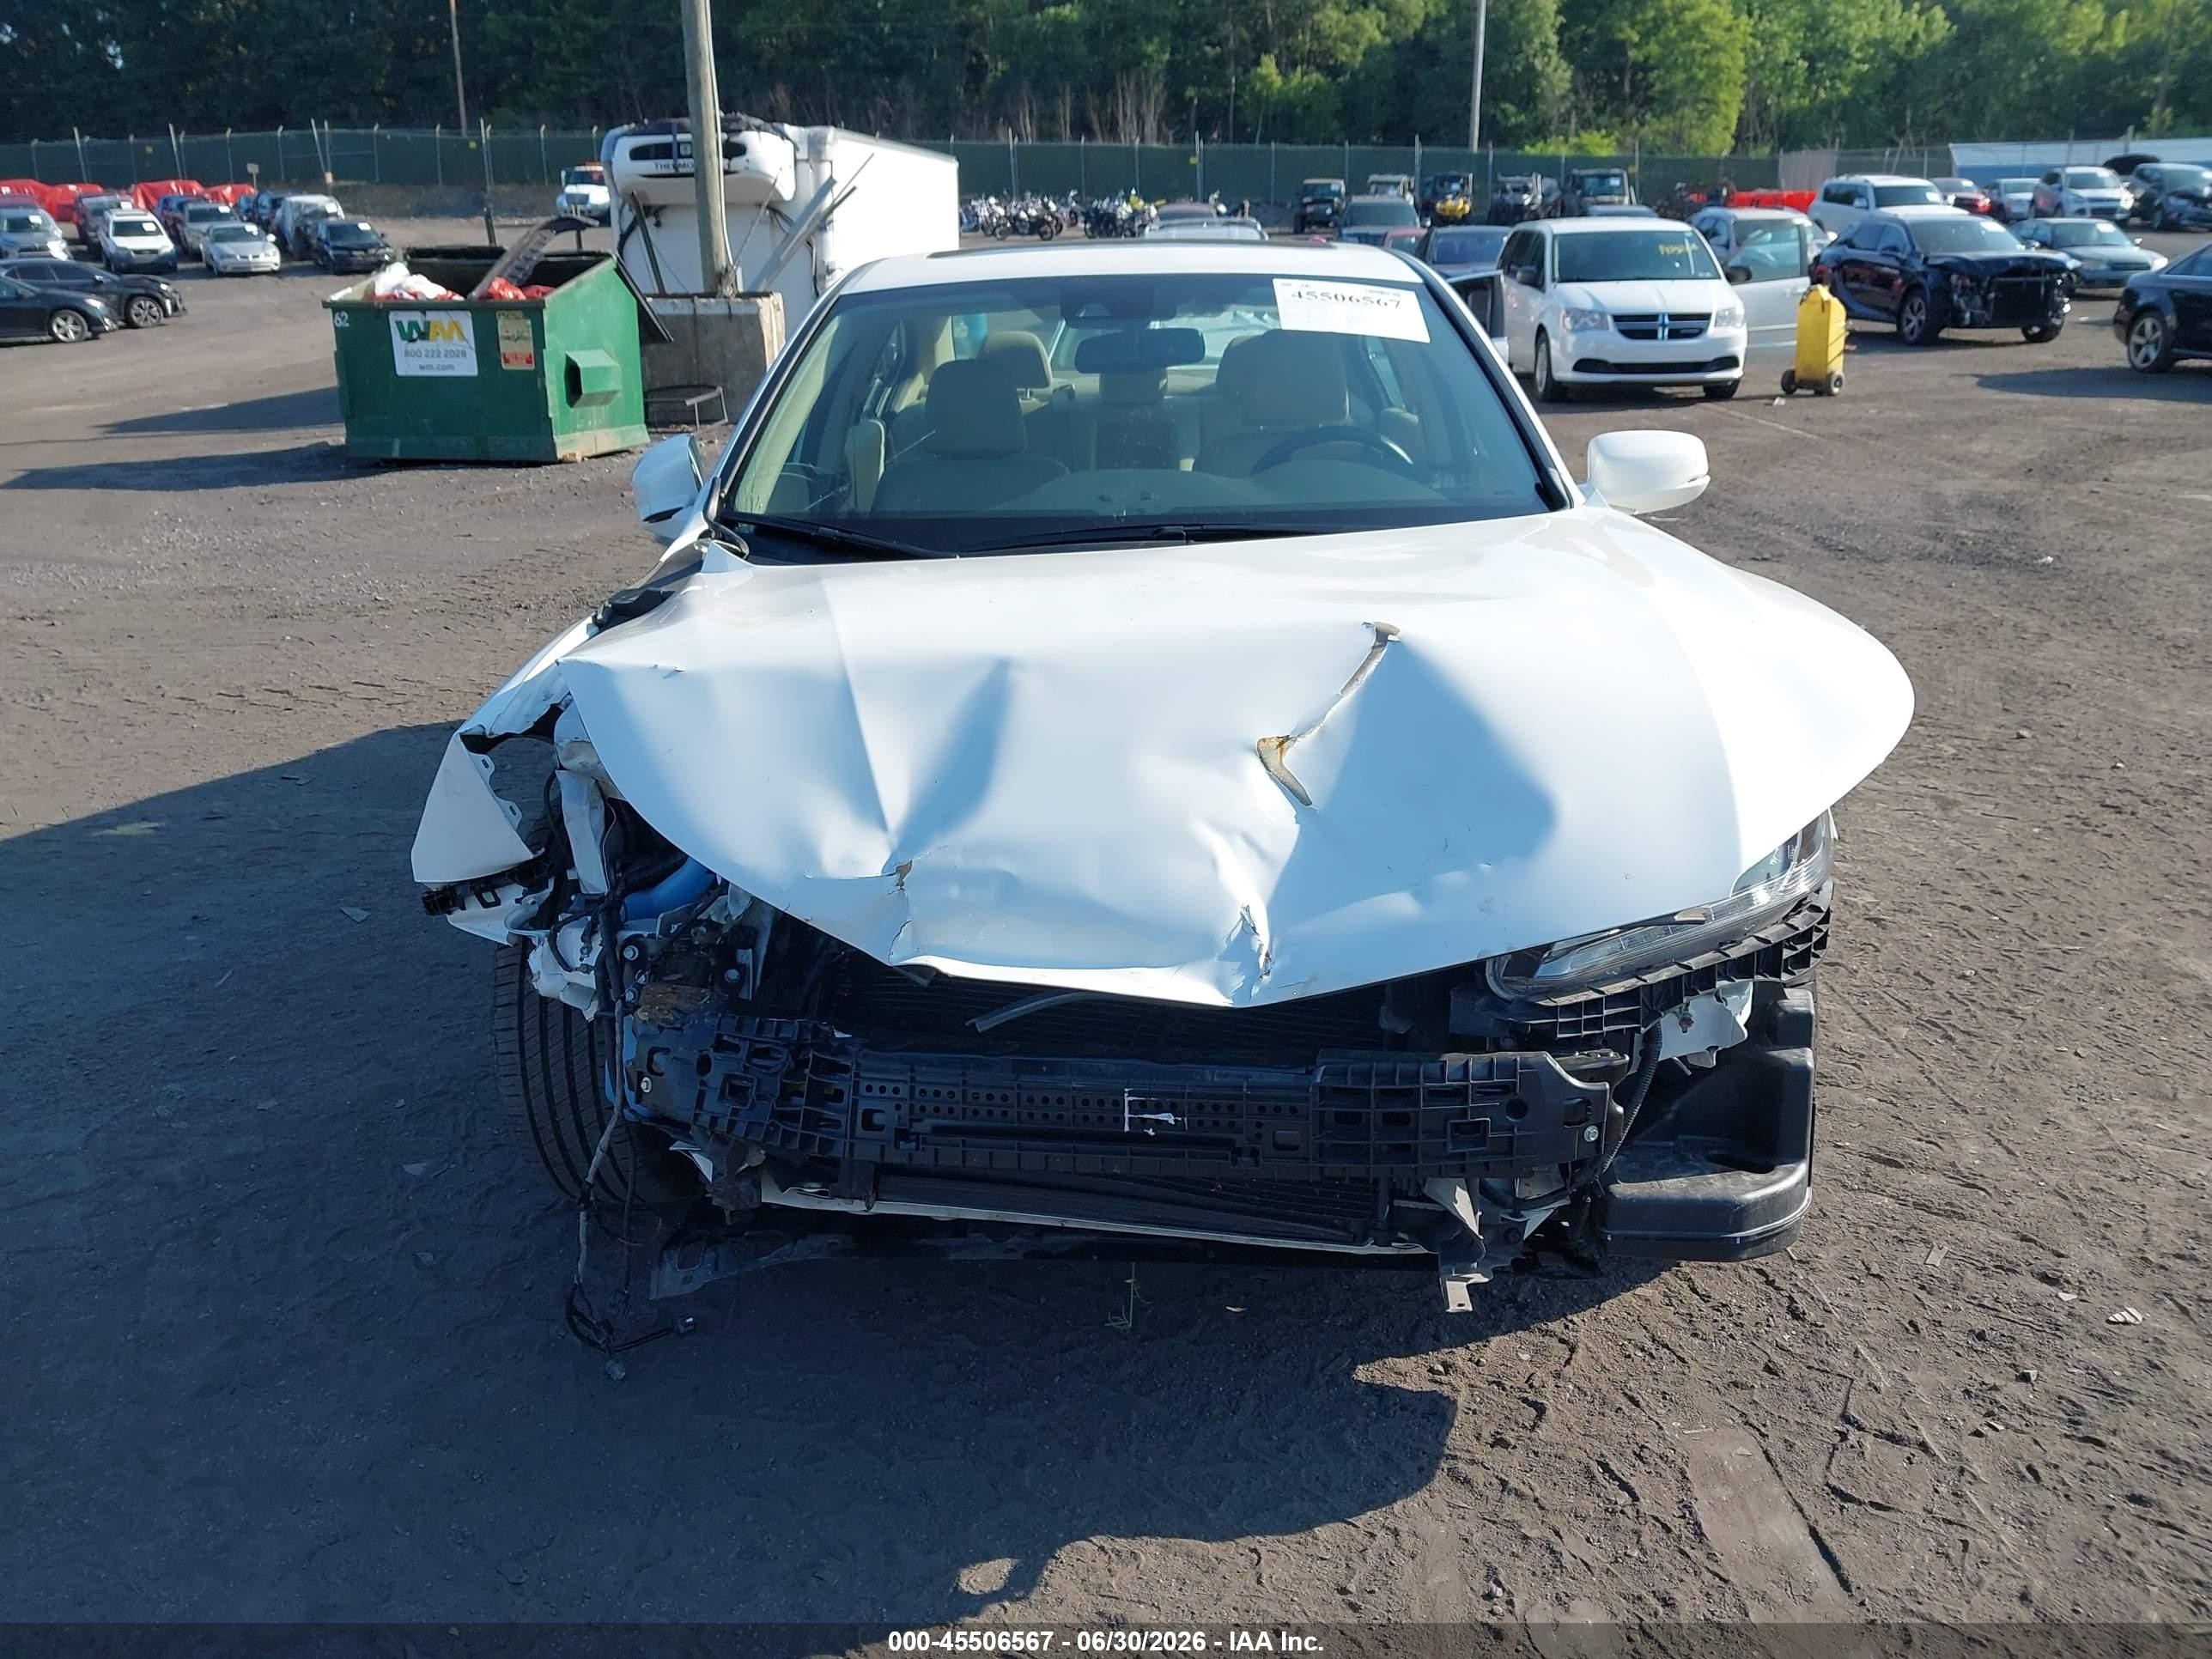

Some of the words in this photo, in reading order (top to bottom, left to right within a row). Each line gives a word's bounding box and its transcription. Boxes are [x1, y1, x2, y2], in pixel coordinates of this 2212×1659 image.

[1291, 290, 1401, 308] 45506567
[334, 312, 349, 327] 62
[395, 320, 465, 343] WM
[419, 363, 455, 372] wm.com
